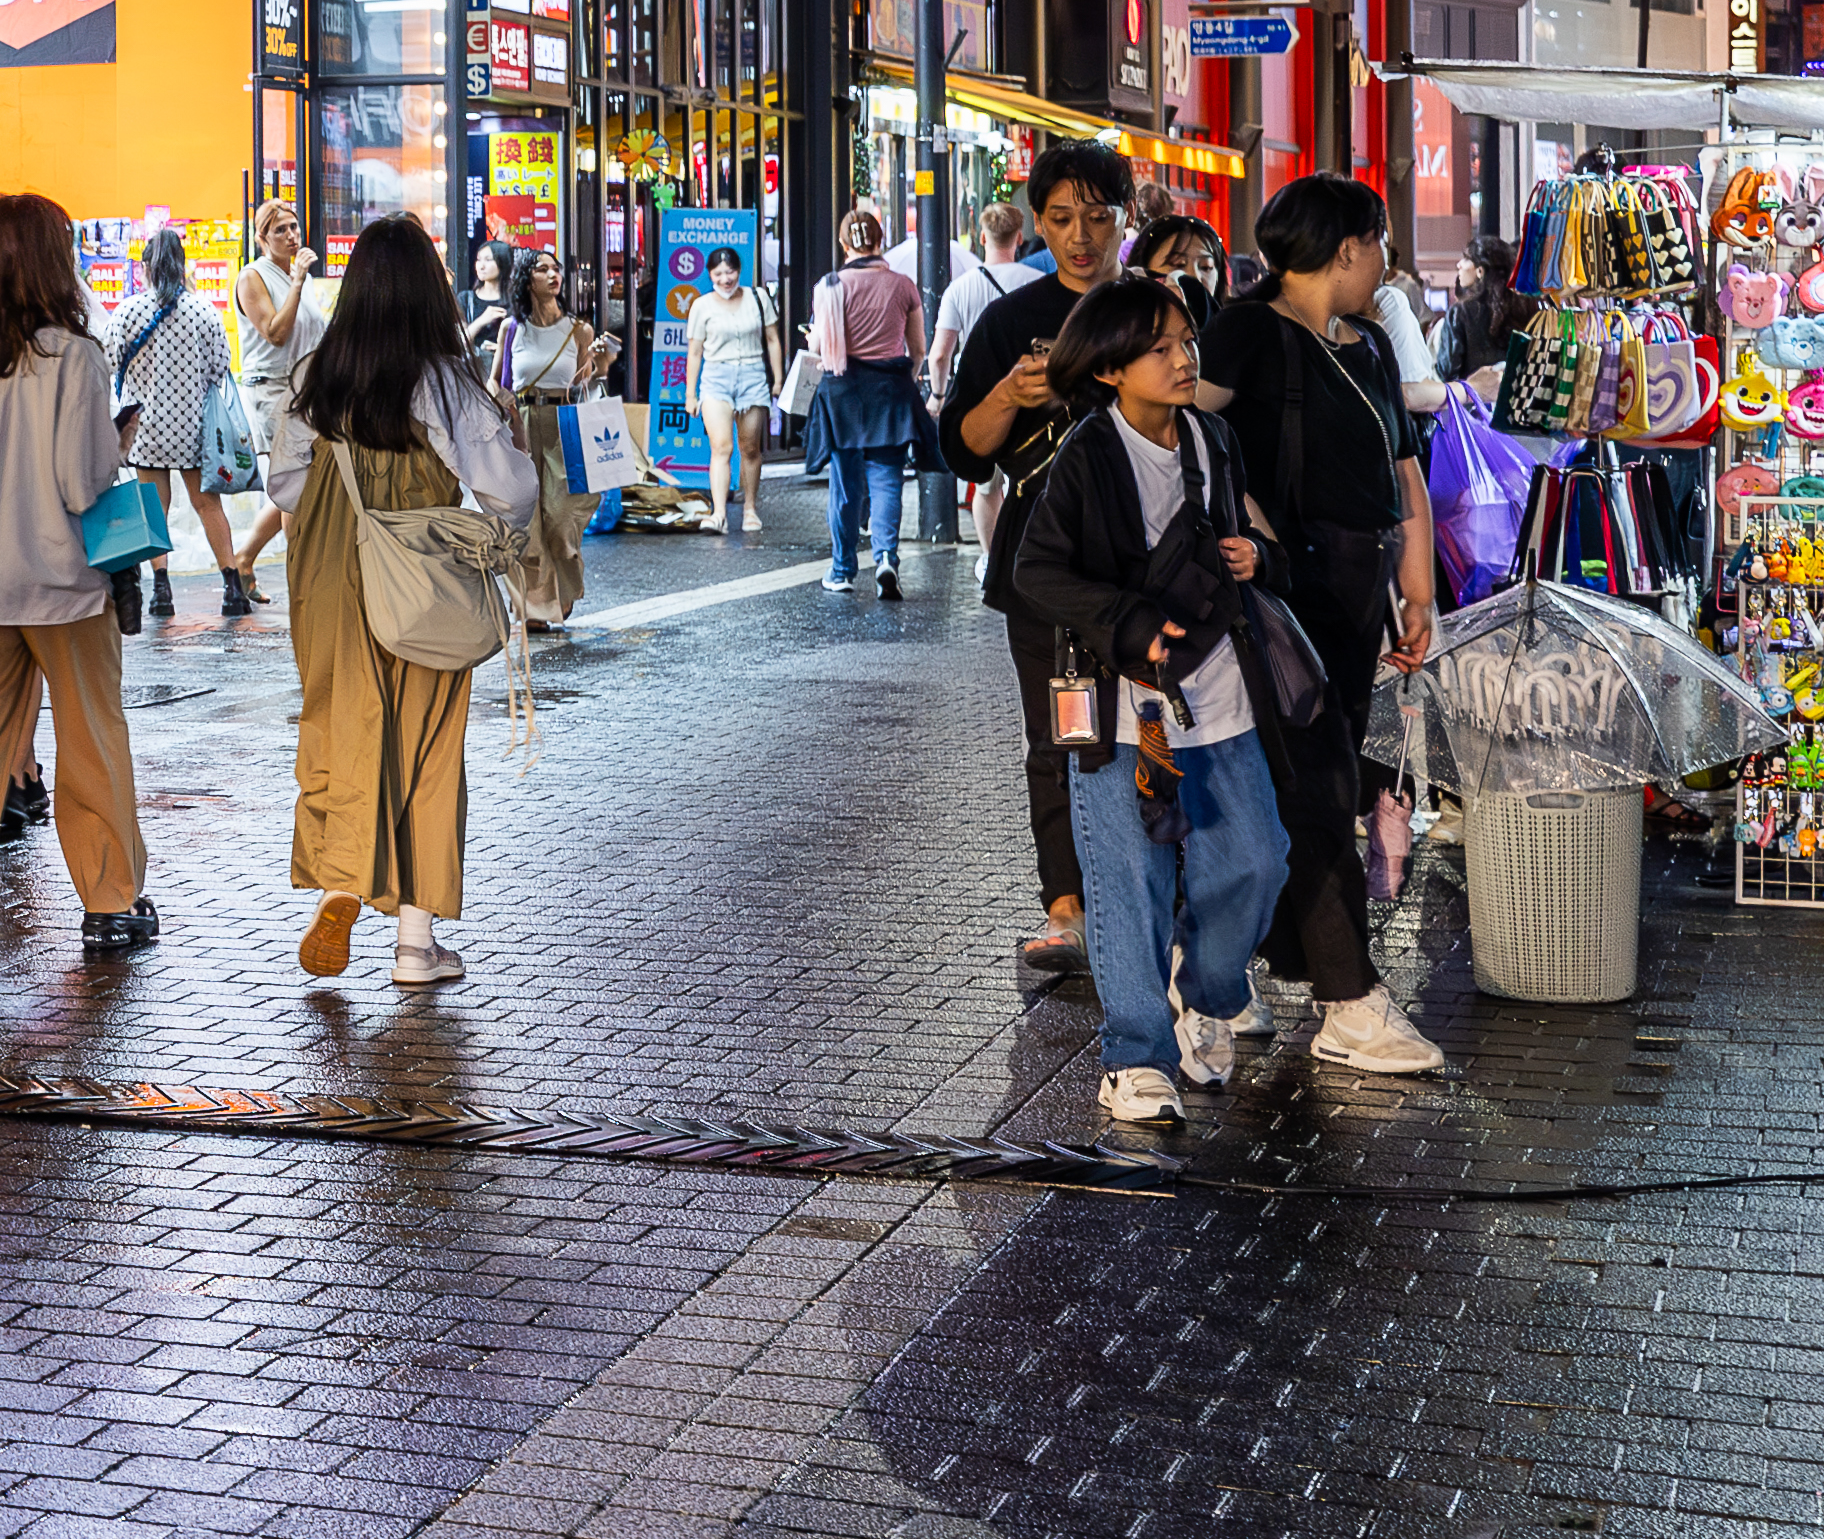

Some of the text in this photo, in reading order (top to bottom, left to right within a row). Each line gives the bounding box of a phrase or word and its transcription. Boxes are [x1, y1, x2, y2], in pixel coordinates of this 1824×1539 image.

[1162, 24, 1190, 98] PAO
[682, 216, 735, 231] MONEY
[667, 230, 750, 245] EXCHANGE
[676, 250, 696, 276] $
[91, 267, 124, 281] SALE
[194, 266, 229, 281] SALE
[91, 280, 124, 293] SALE
[194, 279, 229, 292] SALE
[595, 450, 625, 465] adidas
